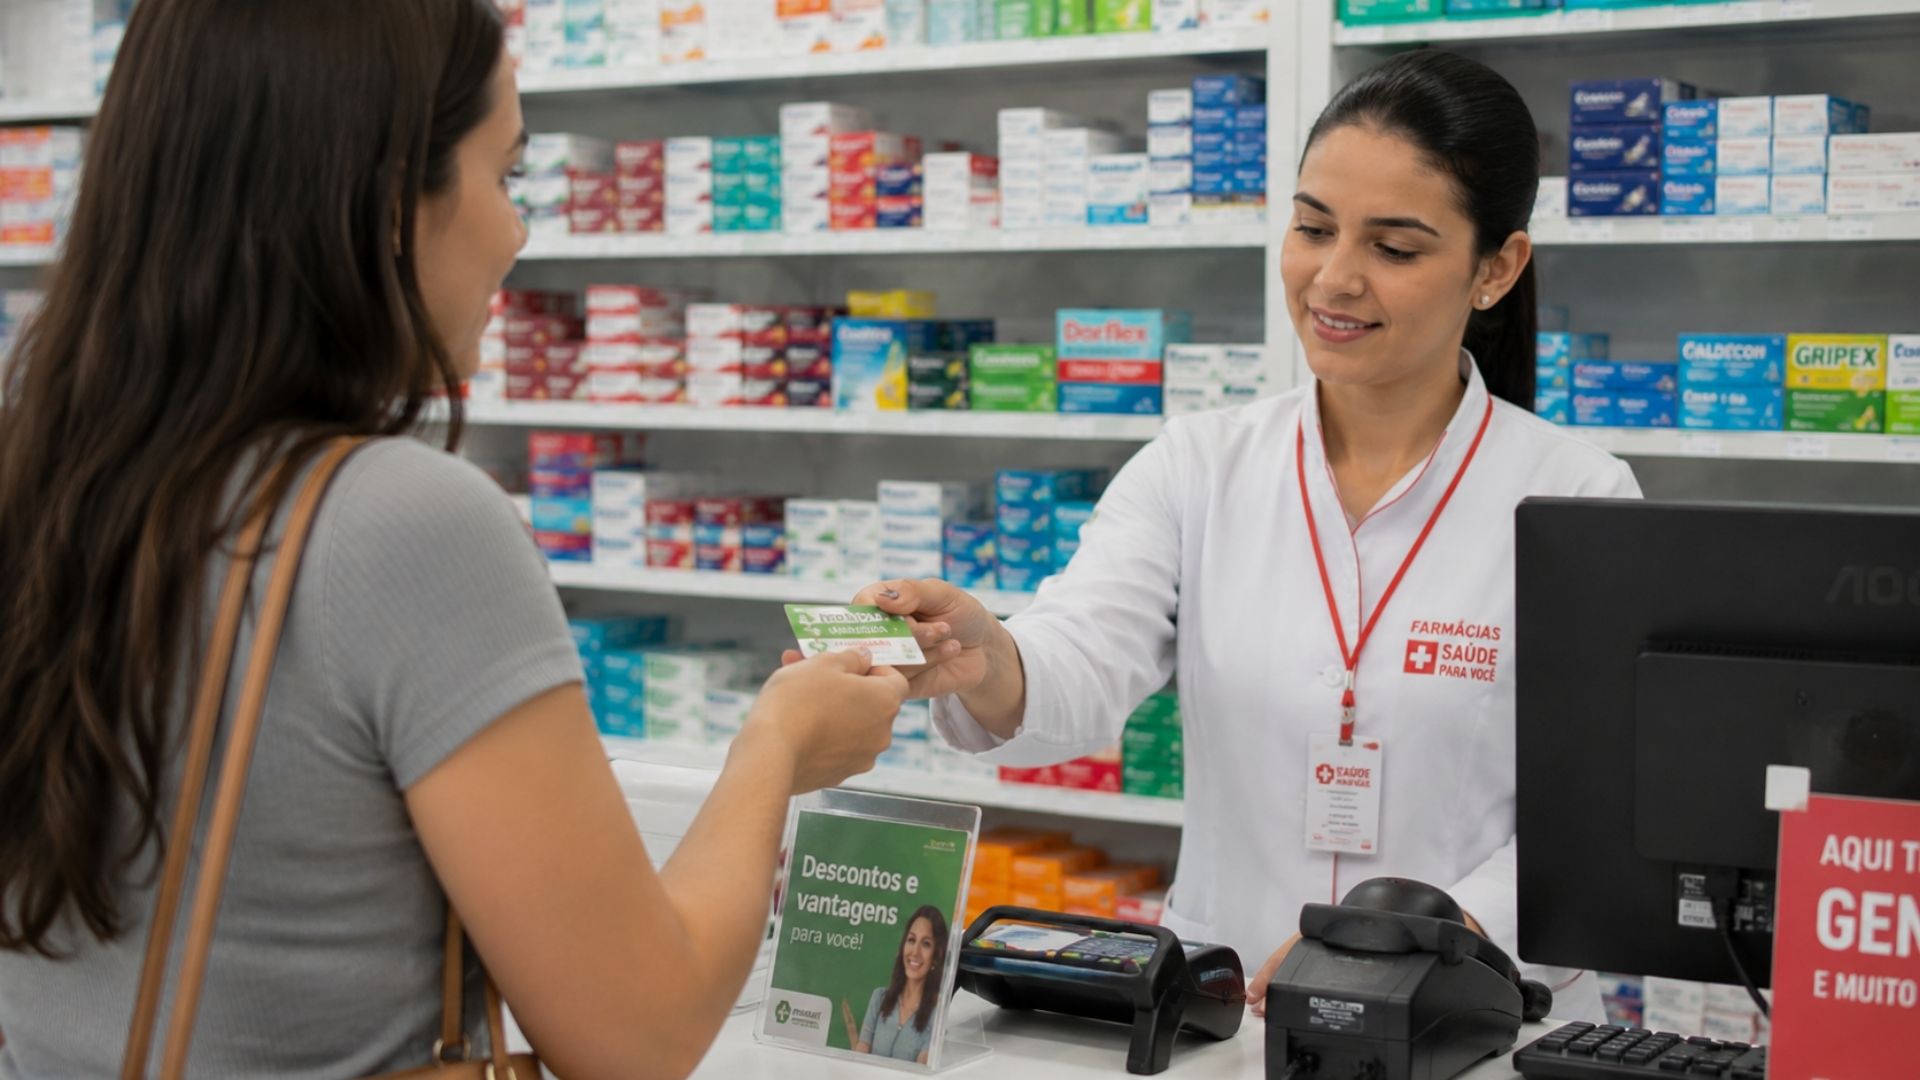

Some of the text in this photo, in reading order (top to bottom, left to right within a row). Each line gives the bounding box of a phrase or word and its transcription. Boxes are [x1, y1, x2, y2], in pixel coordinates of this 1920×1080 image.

[1795, 343, 1878, 368] GRIPEX
[1410, 619, 1501, 641] FARMÁCIAS
[1442, 642, 1498, 666] SAÚDE
[1439, 664, 1496, 682] PARA VOCÊ
[1820, 834, 1920, 873] AQUI T
[801, 854, 919, 894] Descontos e
[797, 892, 898, 925] vantagens
[790, 926, 864, 950] para você!
[1813, 970, 1918, 1008] E MUITO
